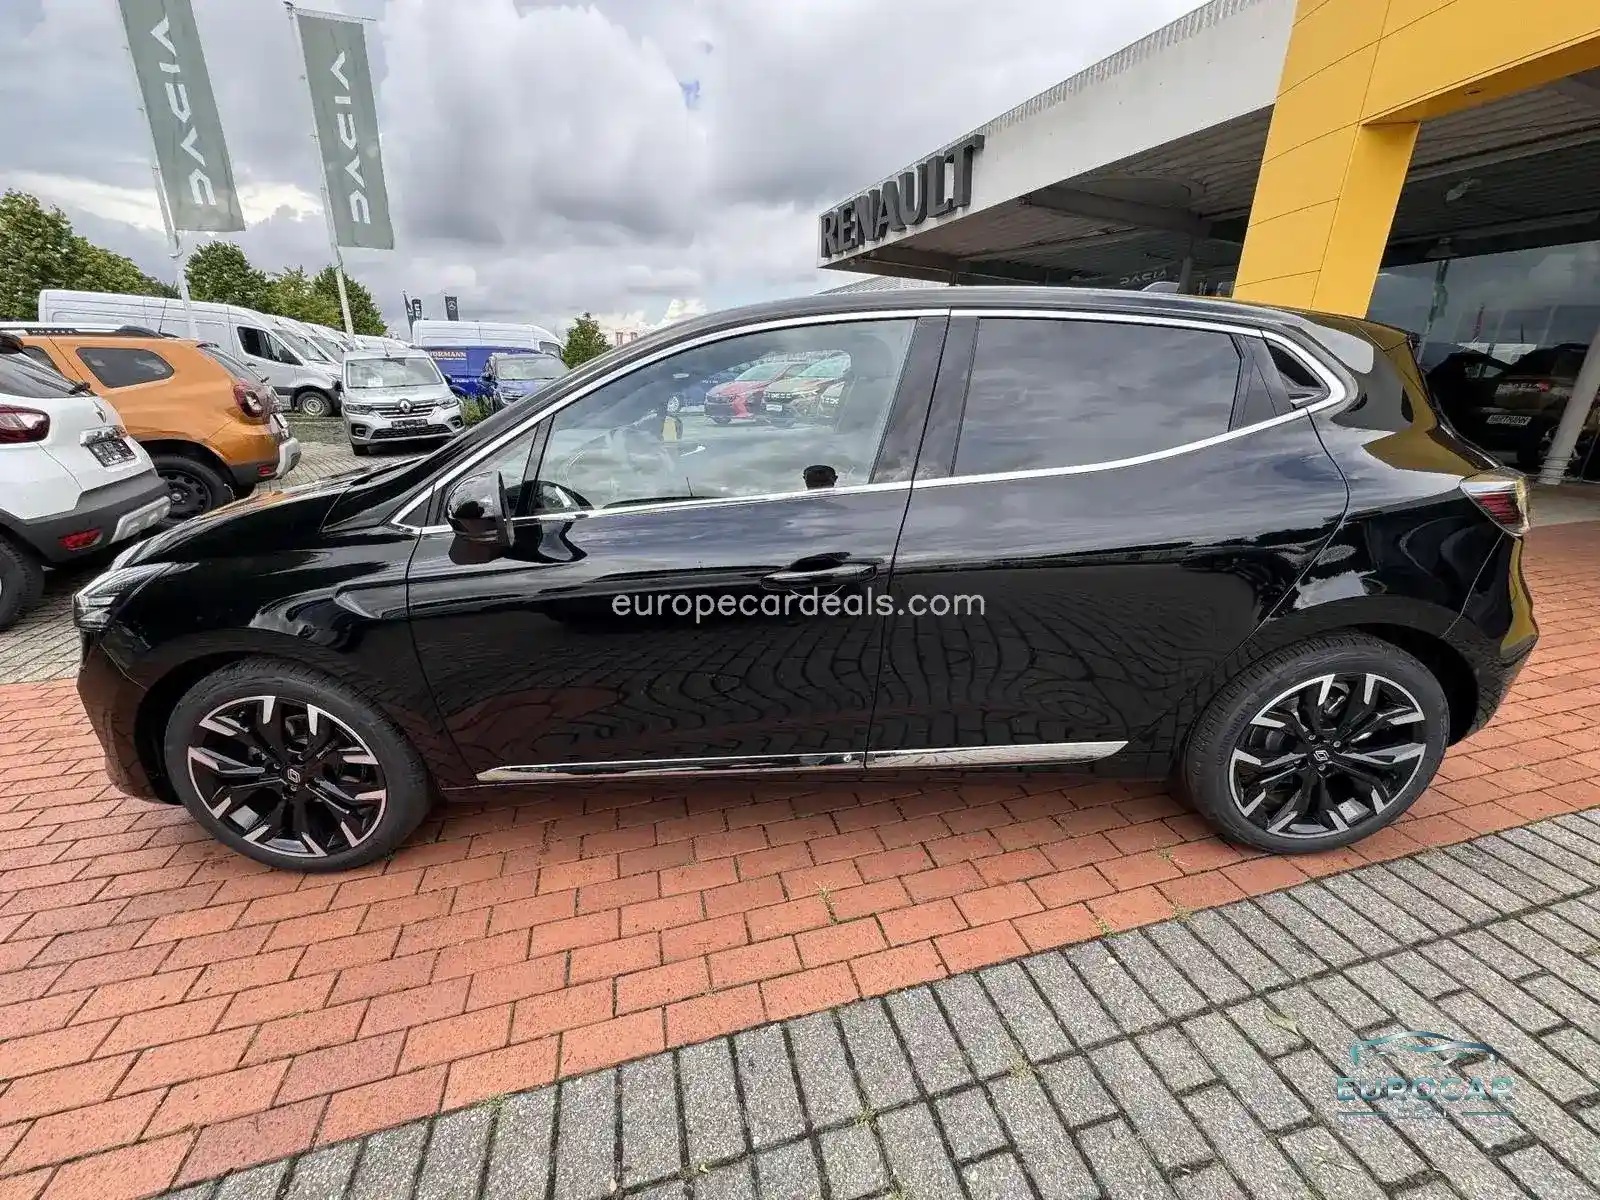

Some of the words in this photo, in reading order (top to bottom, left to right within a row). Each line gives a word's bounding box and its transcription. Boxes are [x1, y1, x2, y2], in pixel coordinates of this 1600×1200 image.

[151, 14, 216, 206] DACIA
[331, 51, 371, 224] DACIA
[821, 134, 985, 258] RENAULT
